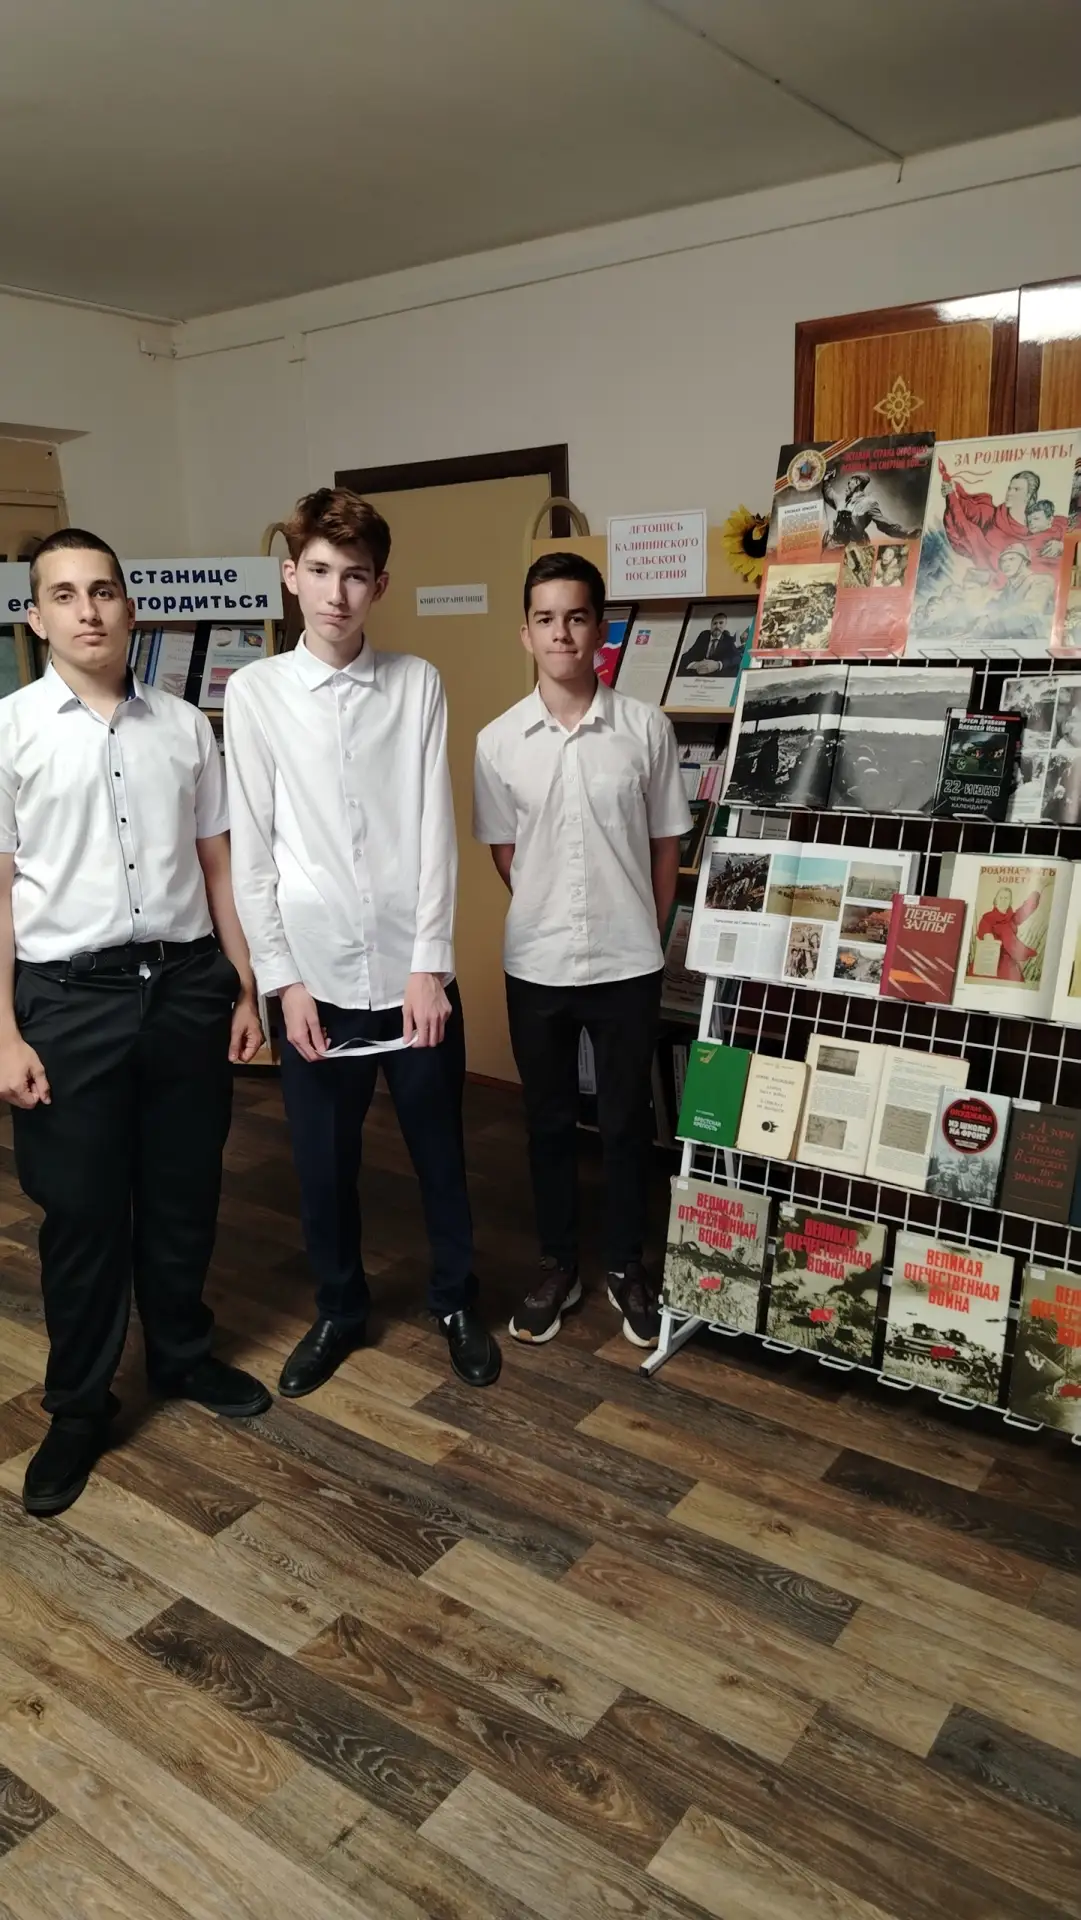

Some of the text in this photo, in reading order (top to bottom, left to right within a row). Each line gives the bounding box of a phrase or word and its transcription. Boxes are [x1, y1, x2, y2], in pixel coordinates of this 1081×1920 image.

[954, 453, 970, 467] ЗА
[629, 522, 684, 535] ЛЕТОПИСЬ
[615, 537, 699, 552] КАЛИНИНСКОГО
[625, 553, 687, 567] СЕЛЬСКОГО
[129, 568, 239, 586] станице
[625, 569, 687, 581] ПОСЕЛЕНИЯ
[137, 594, 269, 614] гордиться
[943, 779, 1001, 797] 22 ИЮНЯ
[981, 866, 1057, 877] РОДИНА-МТЬ
[904, 907, 957, 924] ПЕРВЫЕ
[903, 918, 948, 934] ЗАЛПЫ
[948, 1119, 991, 1135] ИЗ ШКОЛЫ
[948, 1127, 988, 1141] НА ФРОНТ
[696, 1192, 744, 1218] ВЕЛИКАЯ
[677, 1204, 758, 1240] ОТЕЧЕСТВЕННАЯ
[698, 1227, 733, 1251] ВОЙНА
[804, 1218, 857, 1247] ВЕЛИКАЯ
[784, 1231, 872, 1270] ОТЕЧЕСТВЕННАЯ
[807, 1255, 845, 1280] ВОЙНА
[926, 1248, 984, 1279] ВЕЛИКАЯ
[903, 1262, 1000, 1303] ОТЕЧЕСТВЕННАЯ
[928, 1287, 970, 1314] ВОЙНА
